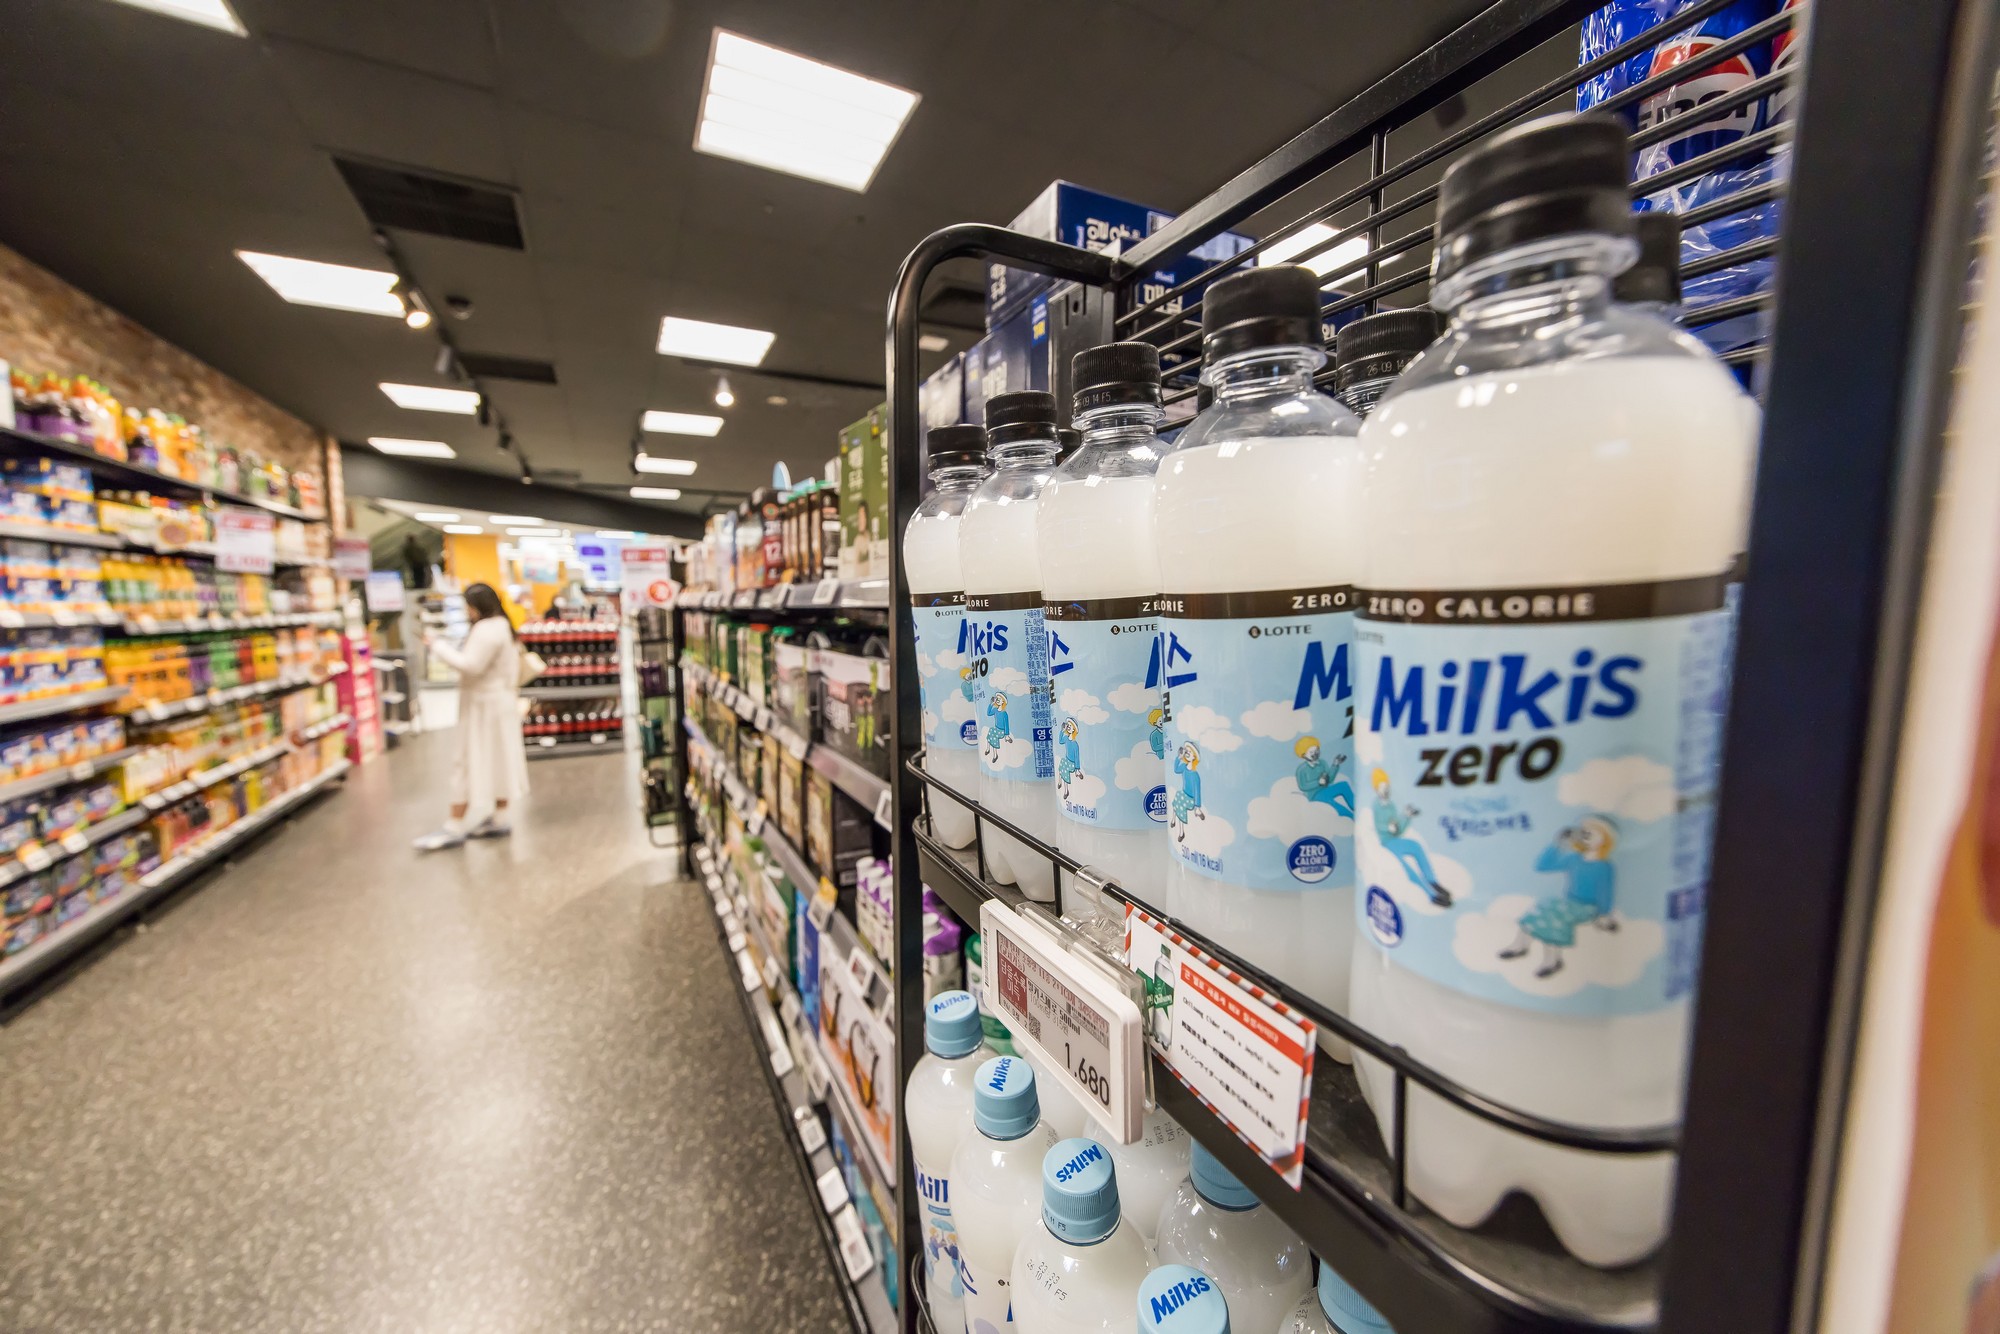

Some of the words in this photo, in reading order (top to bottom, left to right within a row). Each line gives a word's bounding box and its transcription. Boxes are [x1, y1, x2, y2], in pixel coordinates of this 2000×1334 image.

[953, 594, 966, 603] ZE
[968, 599, 989, 608] LORIE
[1292, 592, 1347, 610] ZERO
[1368, 597, 1426, 618] ZERO
[1435, 593, 1596, 618] CALORIE
[1046, 606, 1063, 616] ORIE
[1122, 623, 1158, 634] LOTTE
[1264, 625, 1312, 636] LOTTE
[972, 657, 989, 681] ero
[1370, 646, 1645, 737] Milkis
[1415, 735, 1565, 788] zero
[1153, 793, 1167, 802] ZER
[1294, 855, 1329, 867] CALORIE
[1299, 844, 1326, 857] ZERO
[1000, 959, 1027, 993] 담을수록
[1007, 980, 1021, 1001] 이득
[934, 993, 970, 1014] Milkis
[1060, 1009, 1081, 1036] 500ml
[989, 1057, 1012, 1092] Milkis
[1065, 1042, 1109, 1106] 1,680
[1056, 1144, 1103, 1182] Milkis
[1150, 1277, 1211, 1325] Milkis
